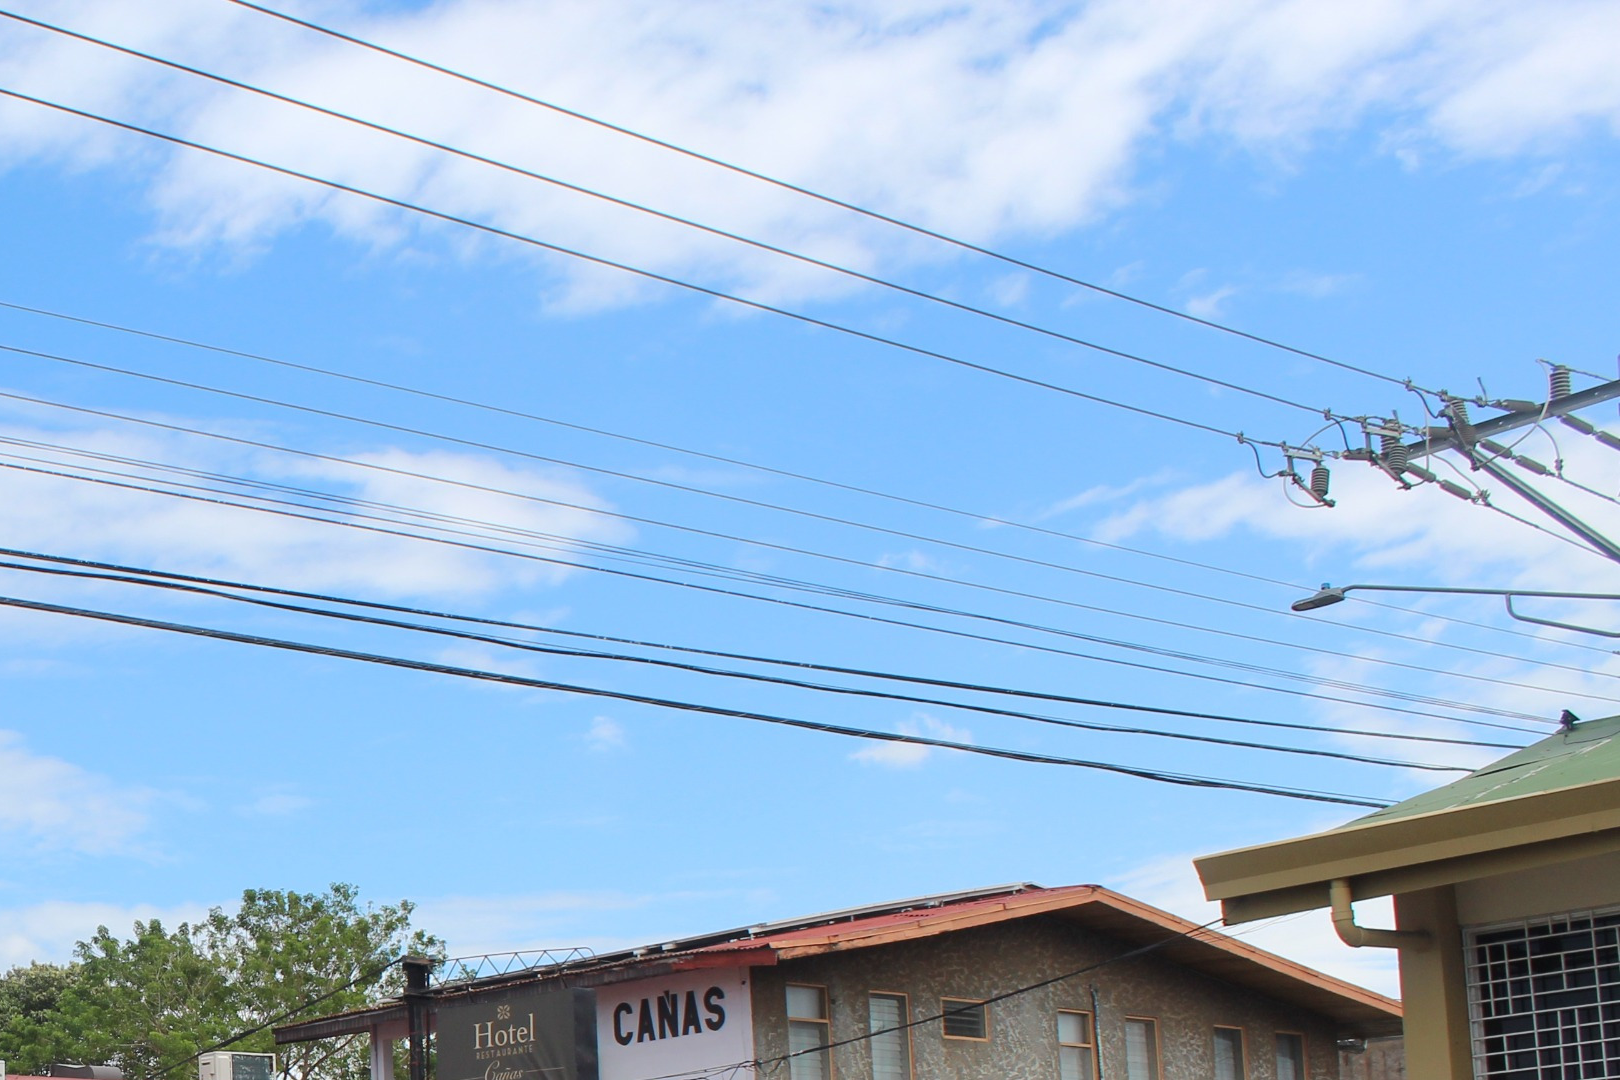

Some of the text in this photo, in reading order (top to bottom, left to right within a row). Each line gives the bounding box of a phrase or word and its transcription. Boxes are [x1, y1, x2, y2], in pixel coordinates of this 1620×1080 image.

[473, 1012, 536, 1050] Hotel
[613, 986, 726, 1046] CAÑAS
[476, 1044, 533, 1060] RESTAURANTE
